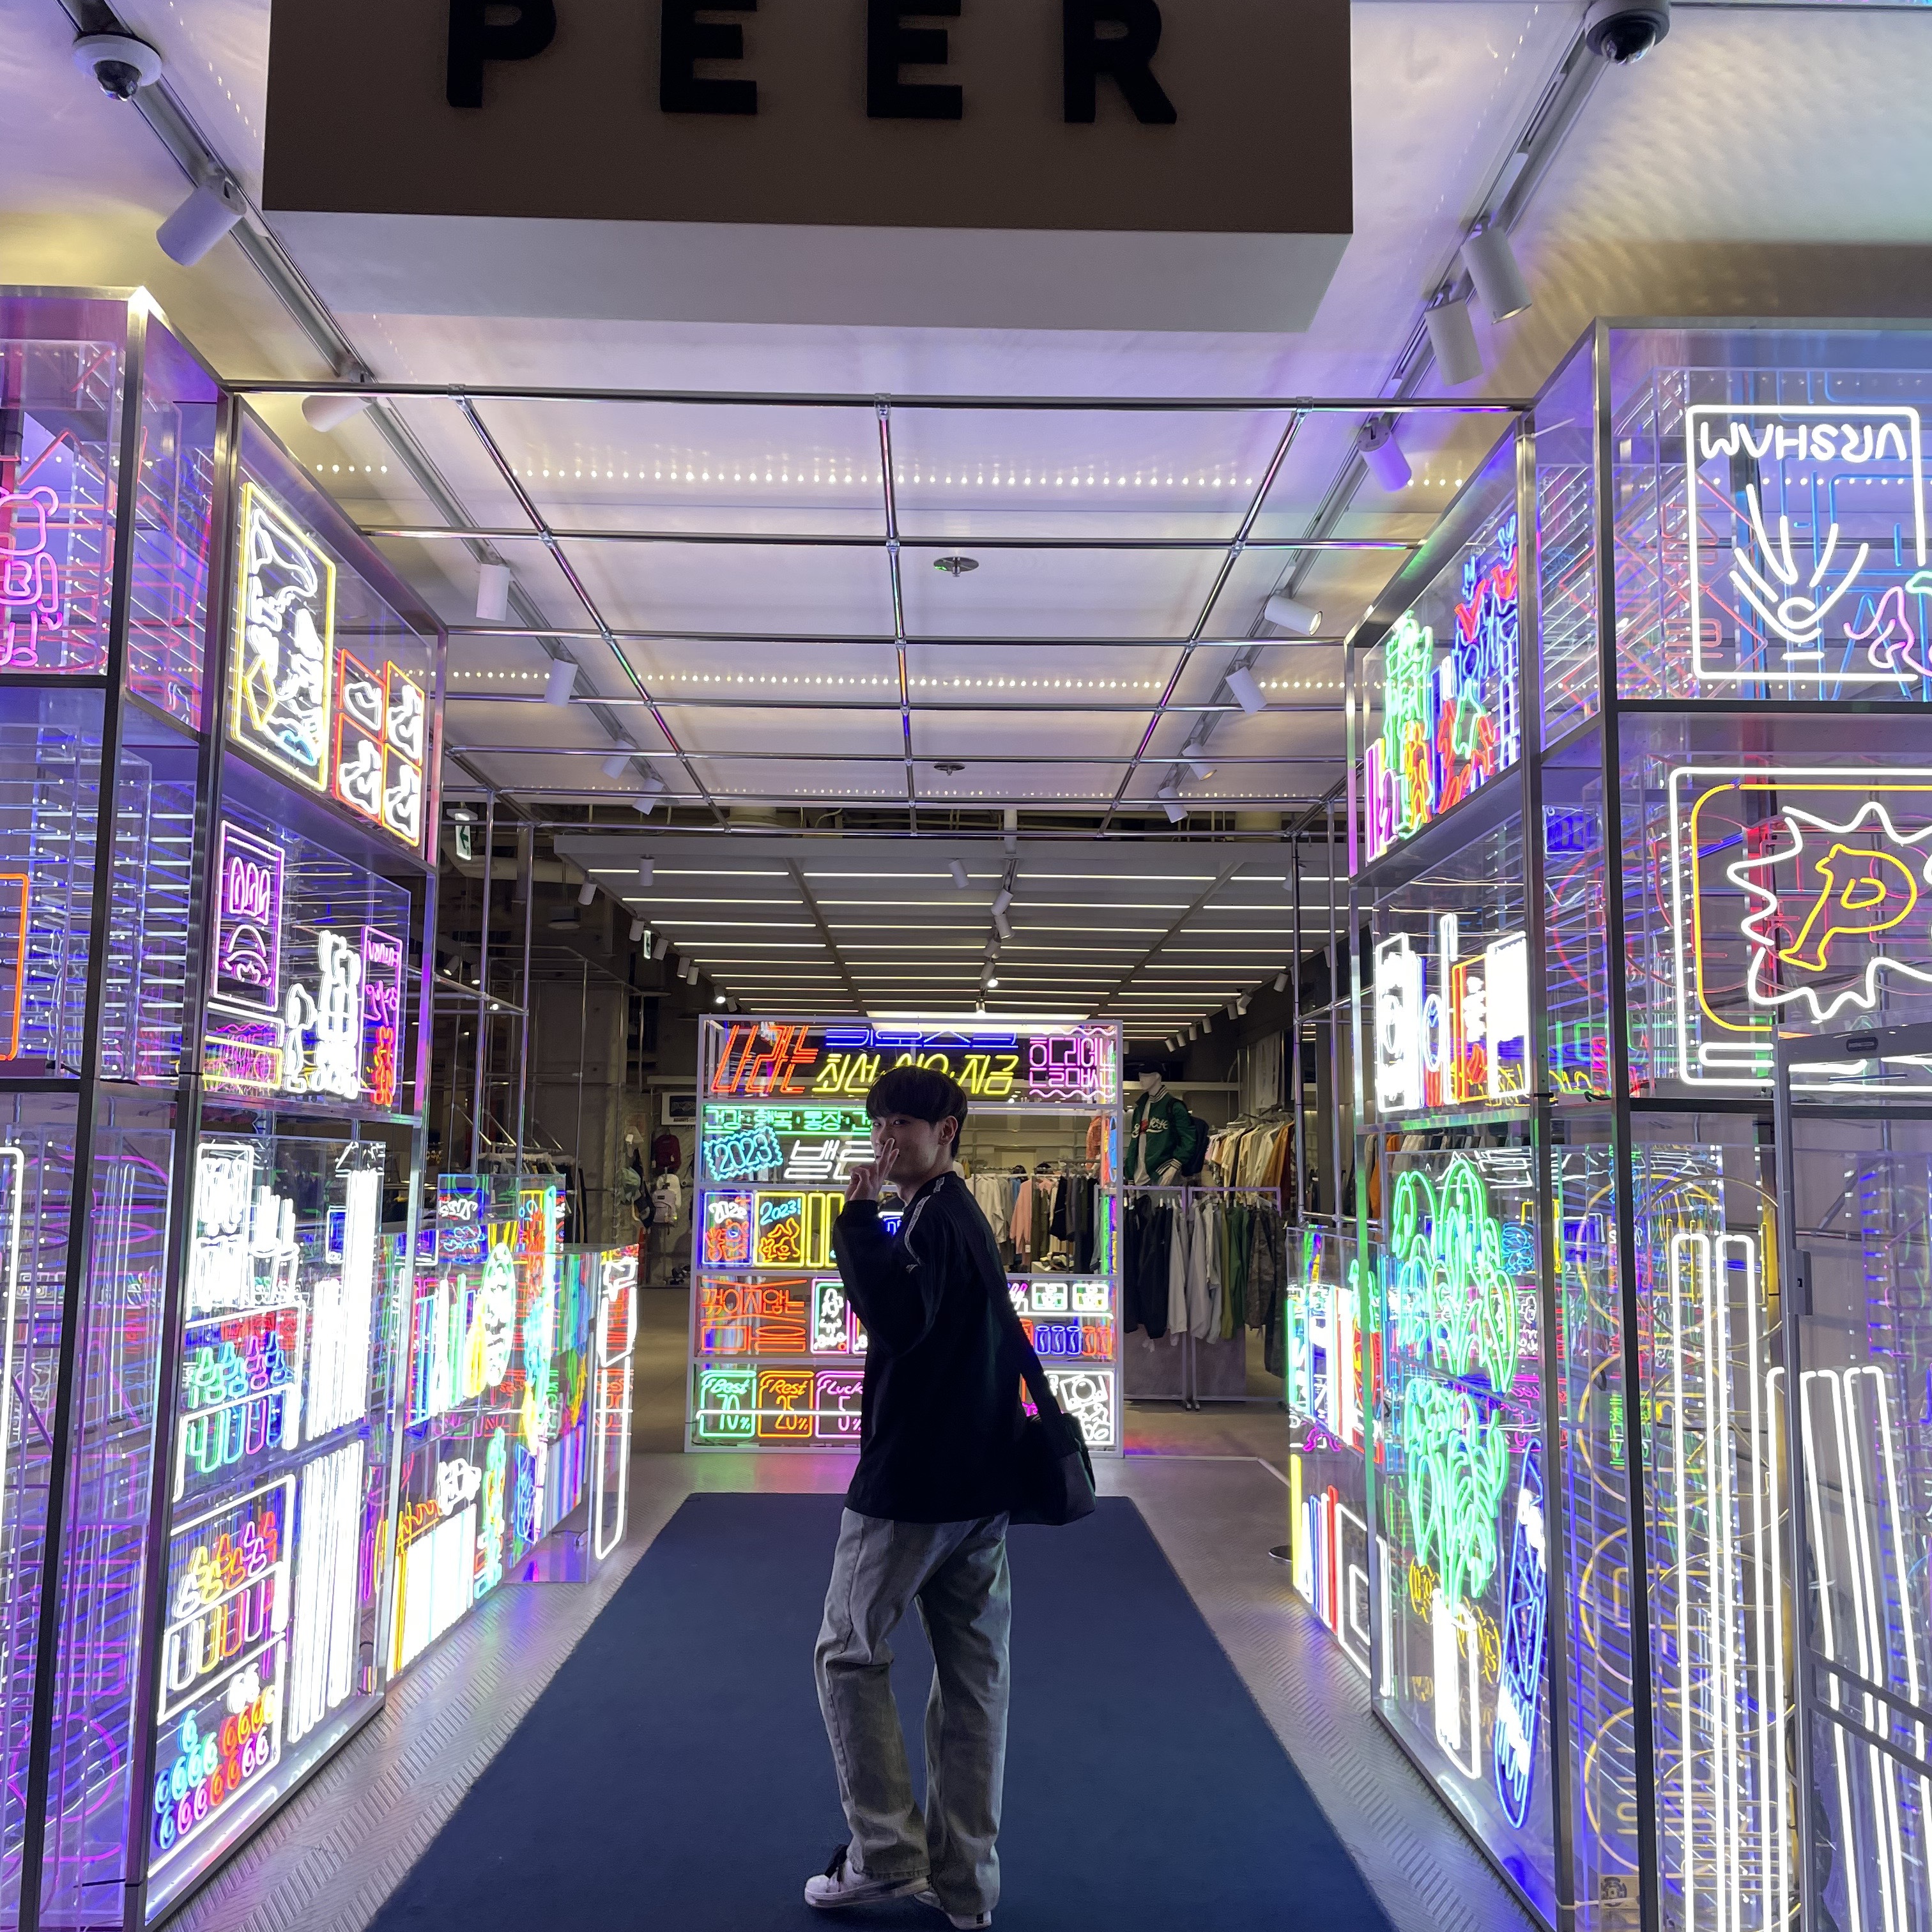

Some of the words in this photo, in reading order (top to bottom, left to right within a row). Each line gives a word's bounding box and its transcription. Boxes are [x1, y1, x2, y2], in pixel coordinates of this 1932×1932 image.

[446, 0, 1177, 125] PEER
[825, 1027, 1019, 1049] 키오스크
[714, 1133, 772, 1173] 2023
[700, 1324, 806, 1353] 마음
